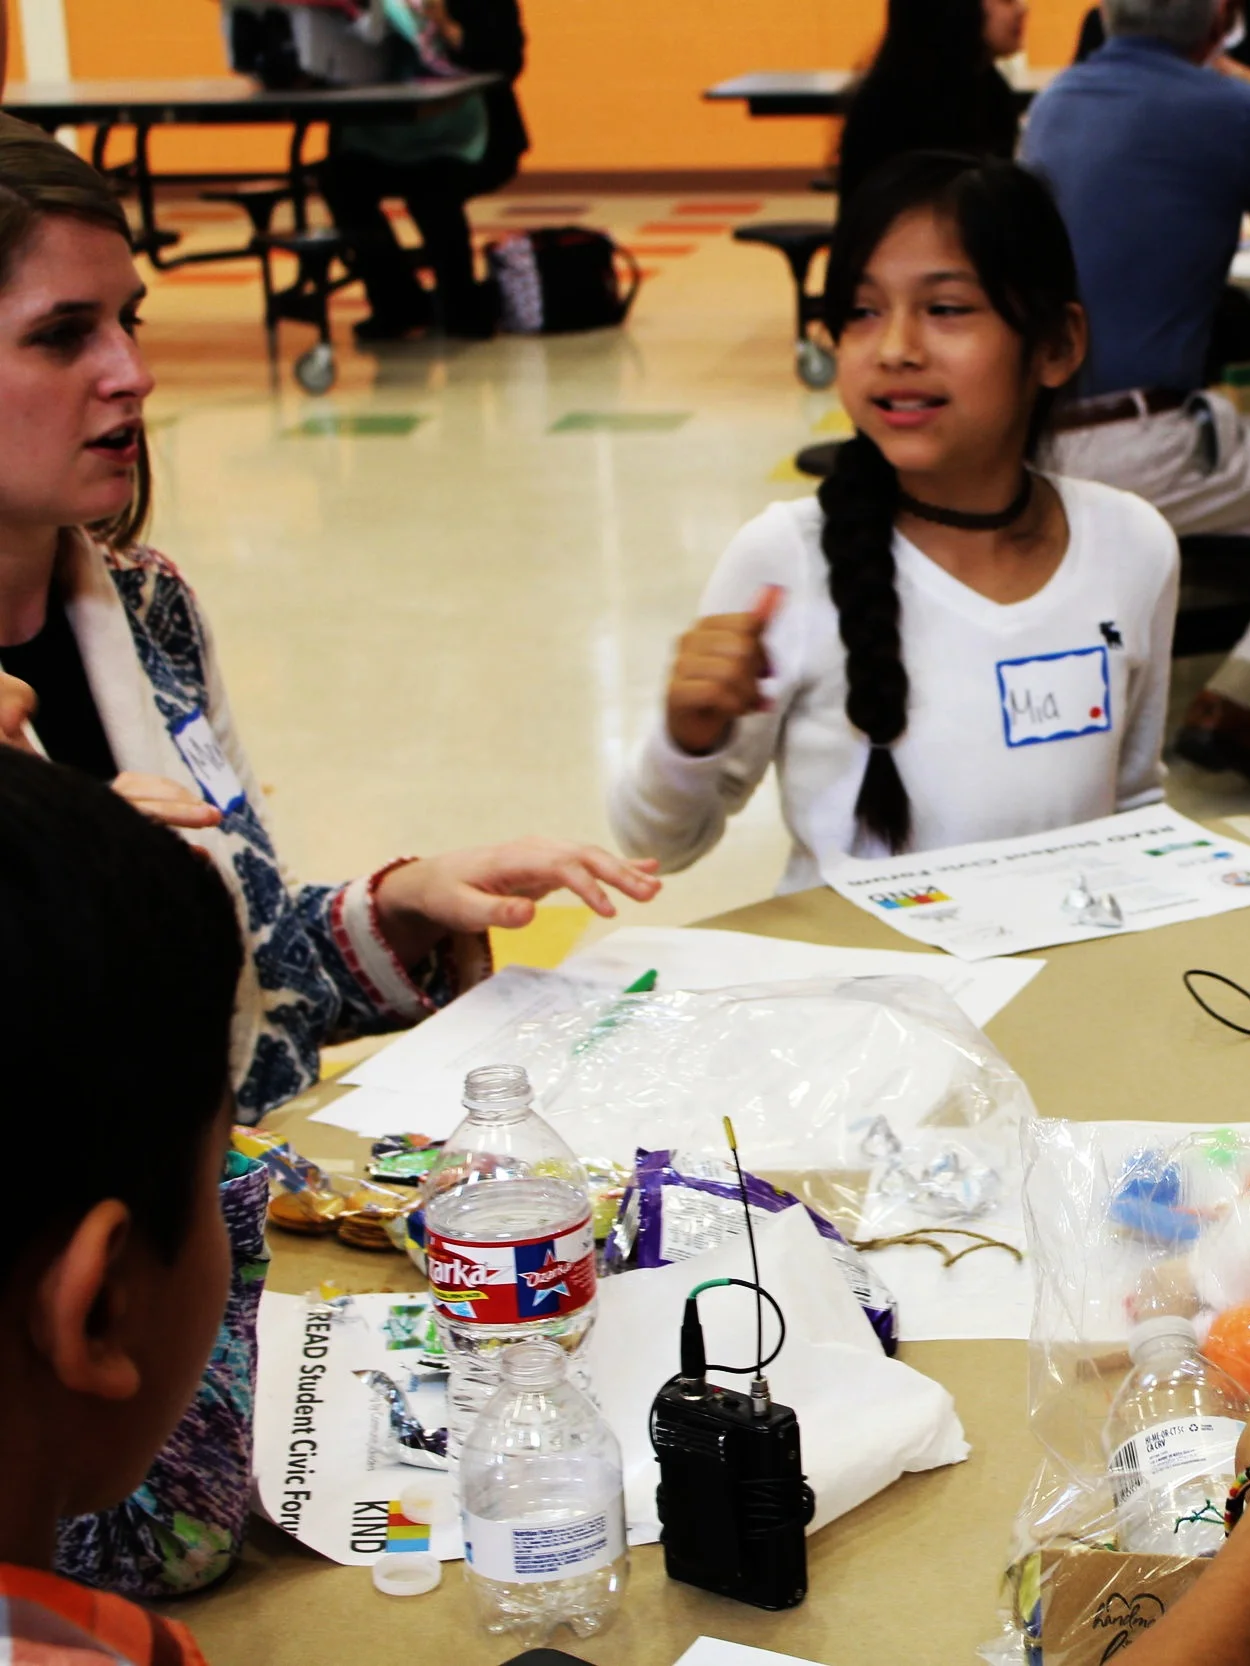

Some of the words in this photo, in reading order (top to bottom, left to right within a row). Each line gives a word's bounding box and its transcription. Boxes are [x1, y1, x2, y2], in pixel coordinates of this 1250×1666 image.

[1009, 688, 1061, 725] Mia
[428, 1257, 488, 1288] arka
[303, 1311, 331, 1359] READ
[291, 1364, 327, 1434] Student
[284, 1439, 318, 1485] Civic
[279, 1490, 312, 1537] Foru
[350, 1500, 390, 1553] KIND
